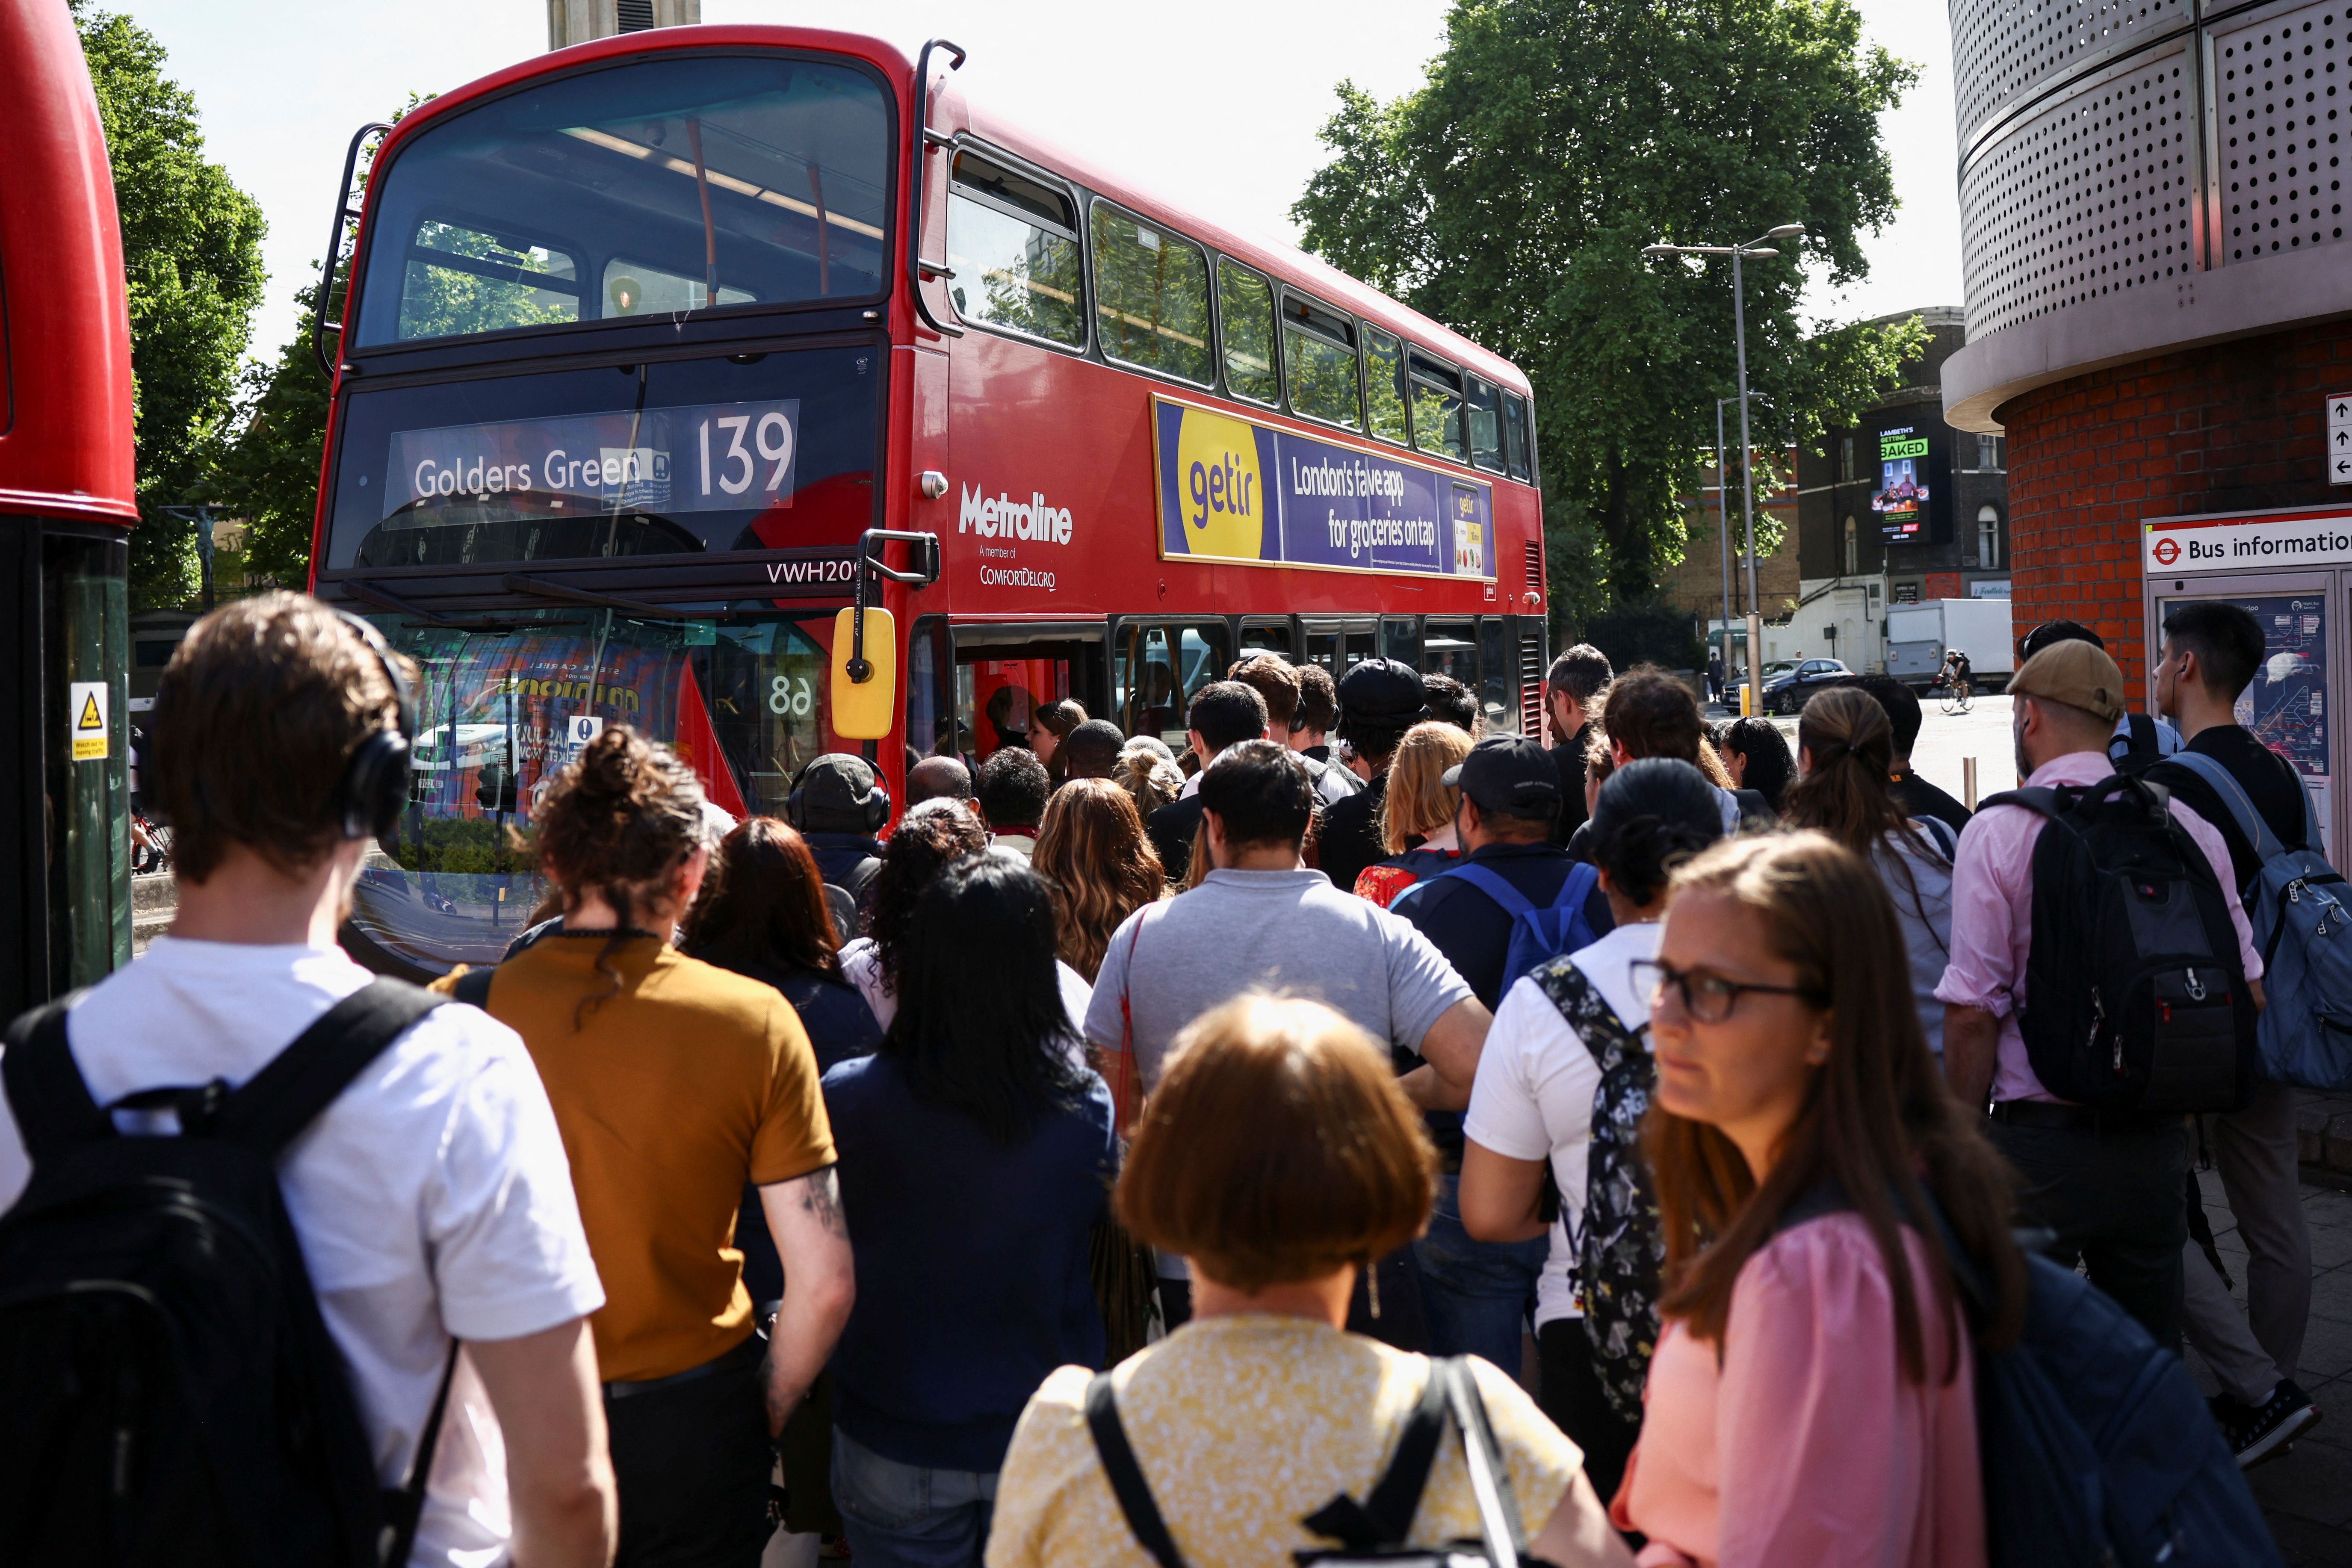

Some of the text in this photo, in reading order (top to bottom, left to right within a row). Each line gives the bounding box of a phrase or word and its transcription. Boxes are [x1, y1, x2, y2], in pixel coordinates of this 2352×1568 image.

[1880, 427, 1914, 437] LAMBETH'S
[1880, 434, 1906, 443] GETTING
[1881, 442, 1924, 457] BAKED
[700, 412, 792, 495] 139
[415, 450, 640, 497] Golders Green
[1190, 452, 1252, 529] getir
[1292, 457, 1404, 506] London's fave app
[958, 481, 1073, 545] Metroline
[1460, 494, 1473, 517] getir
[979, 545, 1016, 558] A member of
[1329, 509, 1434, 558] for groceries on tap
[2189, 532, 2352, 559] Bus informatio
